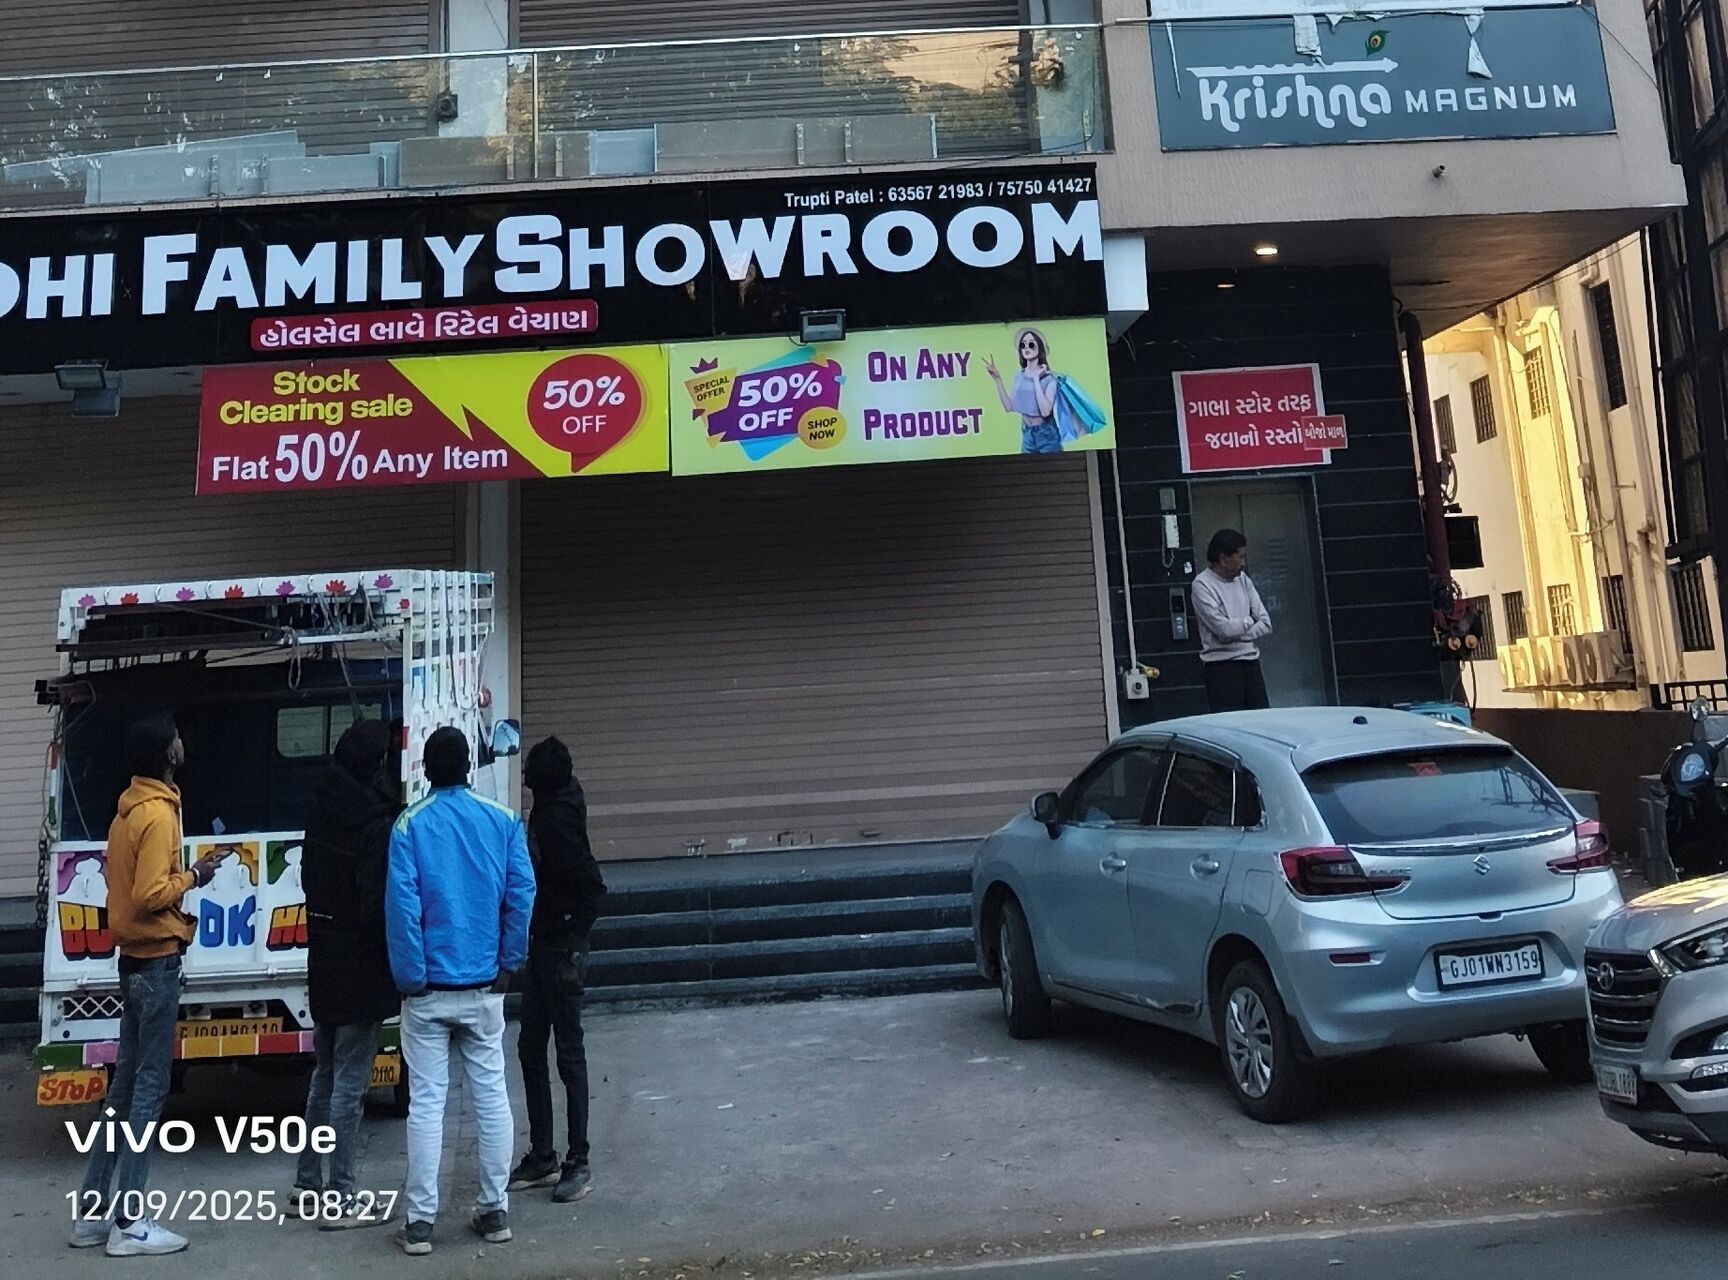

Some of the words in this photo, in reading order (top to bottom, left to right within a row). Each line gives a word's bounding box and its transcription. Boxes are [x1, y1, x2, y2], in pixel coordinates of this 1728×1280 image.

[1199, 75, 1392, 133] Krishna
[1404, 84, 1577, 114] MAGNUM
[784, 192, 830, 209] Trupti
[835, 190, 874, 205] Patel
[888, 185, 933, 201] 63567
[938, 184, 984, 199] 21983
[997, 181, 1042, 196] 75750
[1047, 178, 1092, 193] 41427
[142, 232, 485, 314] FAMILY
[495, 199, 1103, 293] SHOWROOM
[260, 318, 360, 347] હોલસેલ
[370, 313, 425, 341] ભાવે
[508, 307, 587, 332] વેચાણ
[273, 368, 360, 395] Stock
[543, 376, 626, 410] 50%
[693, 376, 730, 394] SPECIAL
[697, 387, 725, 402] OFFER
[738, 370, 822, 408] 50%
[219, 398, 342, 426] Clearing
[351, 393, 413, 419] sale
[1190, 399, 1230, 417] ગાભા
[1235, 391, 1272, 414] સ્ટોર
[1278, 394, 1312, 413] તરફ
[563, 415, 607, 435] OFF
[739, 407, 793, 432] OFF
[807, 417, 838, 430] SHOP
[809, 428, 835, 440] NOW
[1205, 424, 1259, 449] જવાનો
[1266, 421, 1303, 445] રસ્તો
[213, 456, 269, 481] Flat
[275, 430, 368, 483] 50%
[373, 448, 434, 479] Any
[444, 445, 508, 471] Item
[1450, 950, 1538, 978] GJ01WN3159
